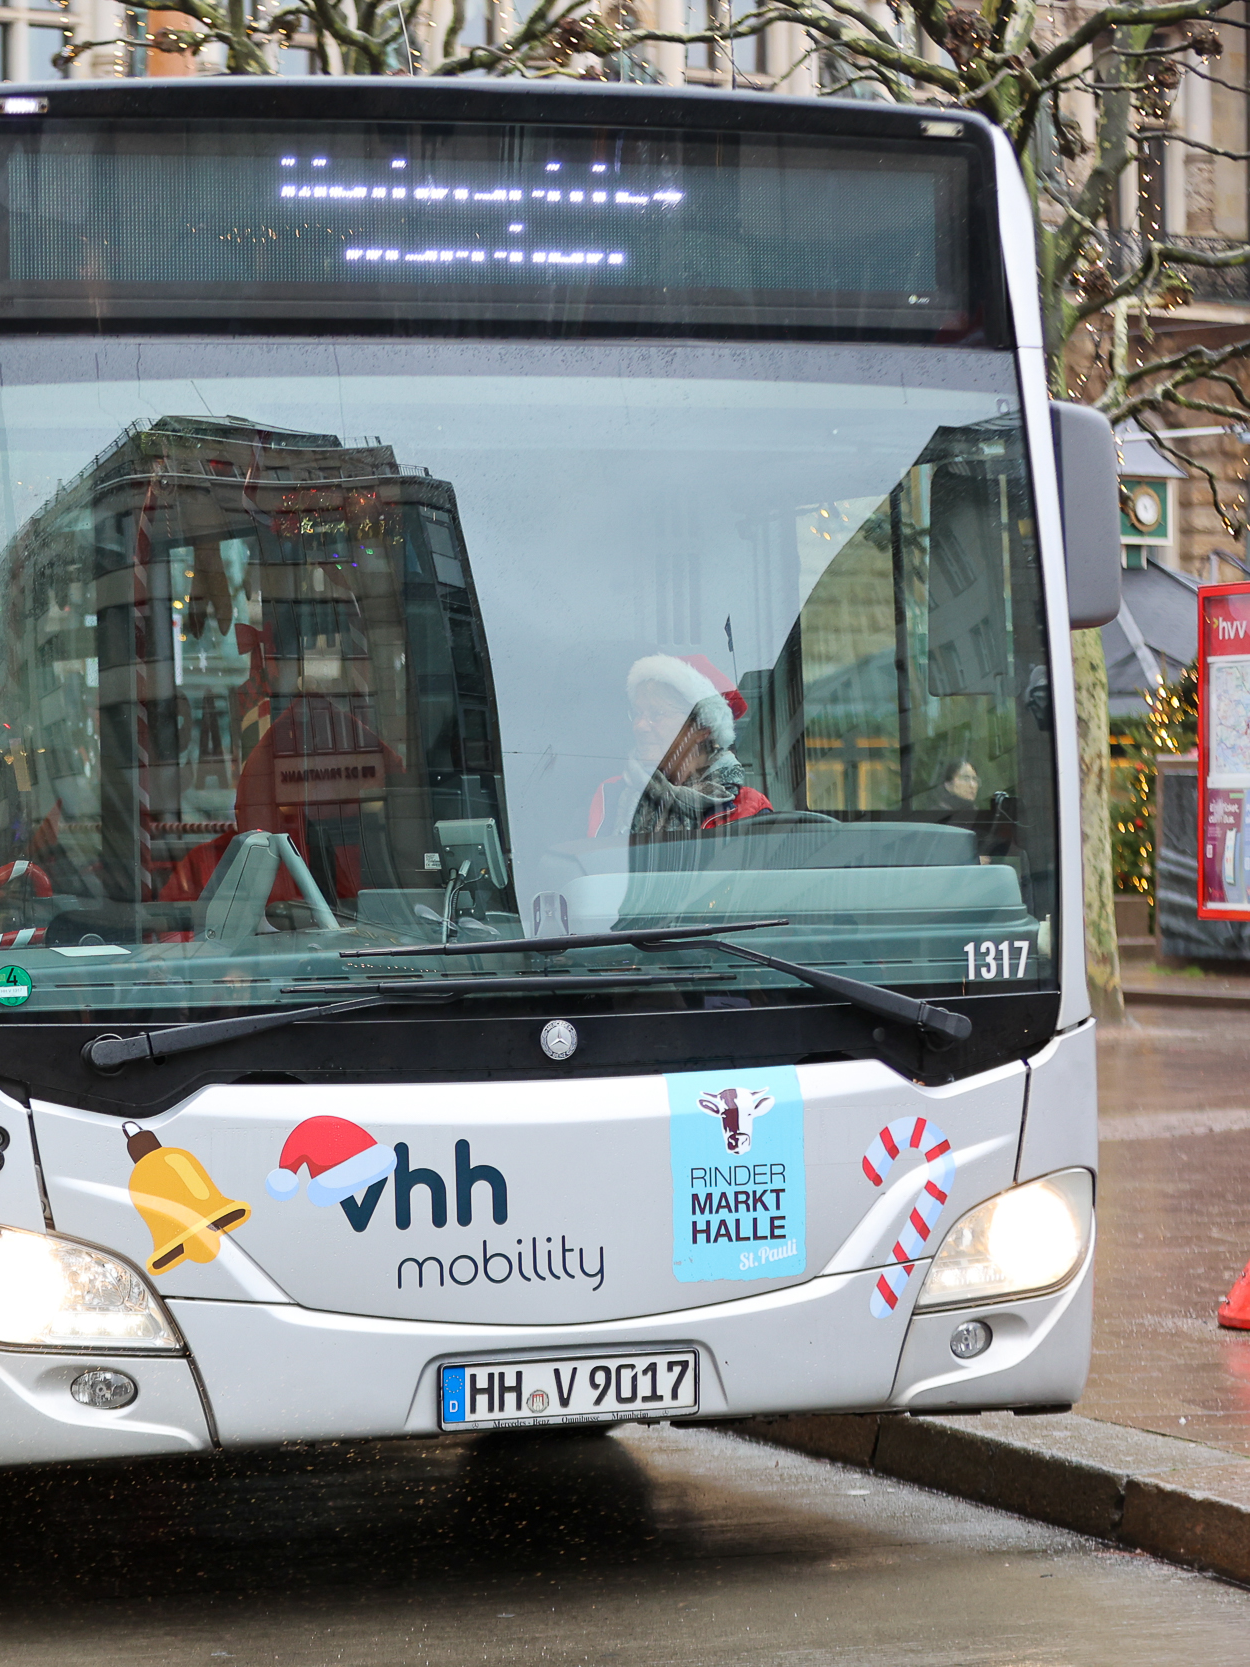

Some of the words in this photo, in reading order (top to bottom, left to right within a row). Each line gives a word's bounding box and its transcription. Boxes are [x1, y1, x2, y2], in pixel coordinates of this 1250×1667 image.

[1219, 616, 1247, 640] hvv
[964, 940, 1030, 980] 1317
[6, 967, 18, 986] 4
[339, 1139, 508, 1232] vhh
[690, 1163, 786, 1188] RINDER
[691, 1188, 786, 1216] MARKT
[691, 1216, 787, 1244] HALLE
[397, 1235, 605, 1292] mobility
[469, 1370, 523, 1414] HH
[553, 1366, 578, 1408] V
[588, 1359, 690, 1407] 9017
[449, 1400, 458, 1413] D
[561, 1415, 600, 1424] Omnibusse
[611, 1411, 649, 1421] Mannheim
